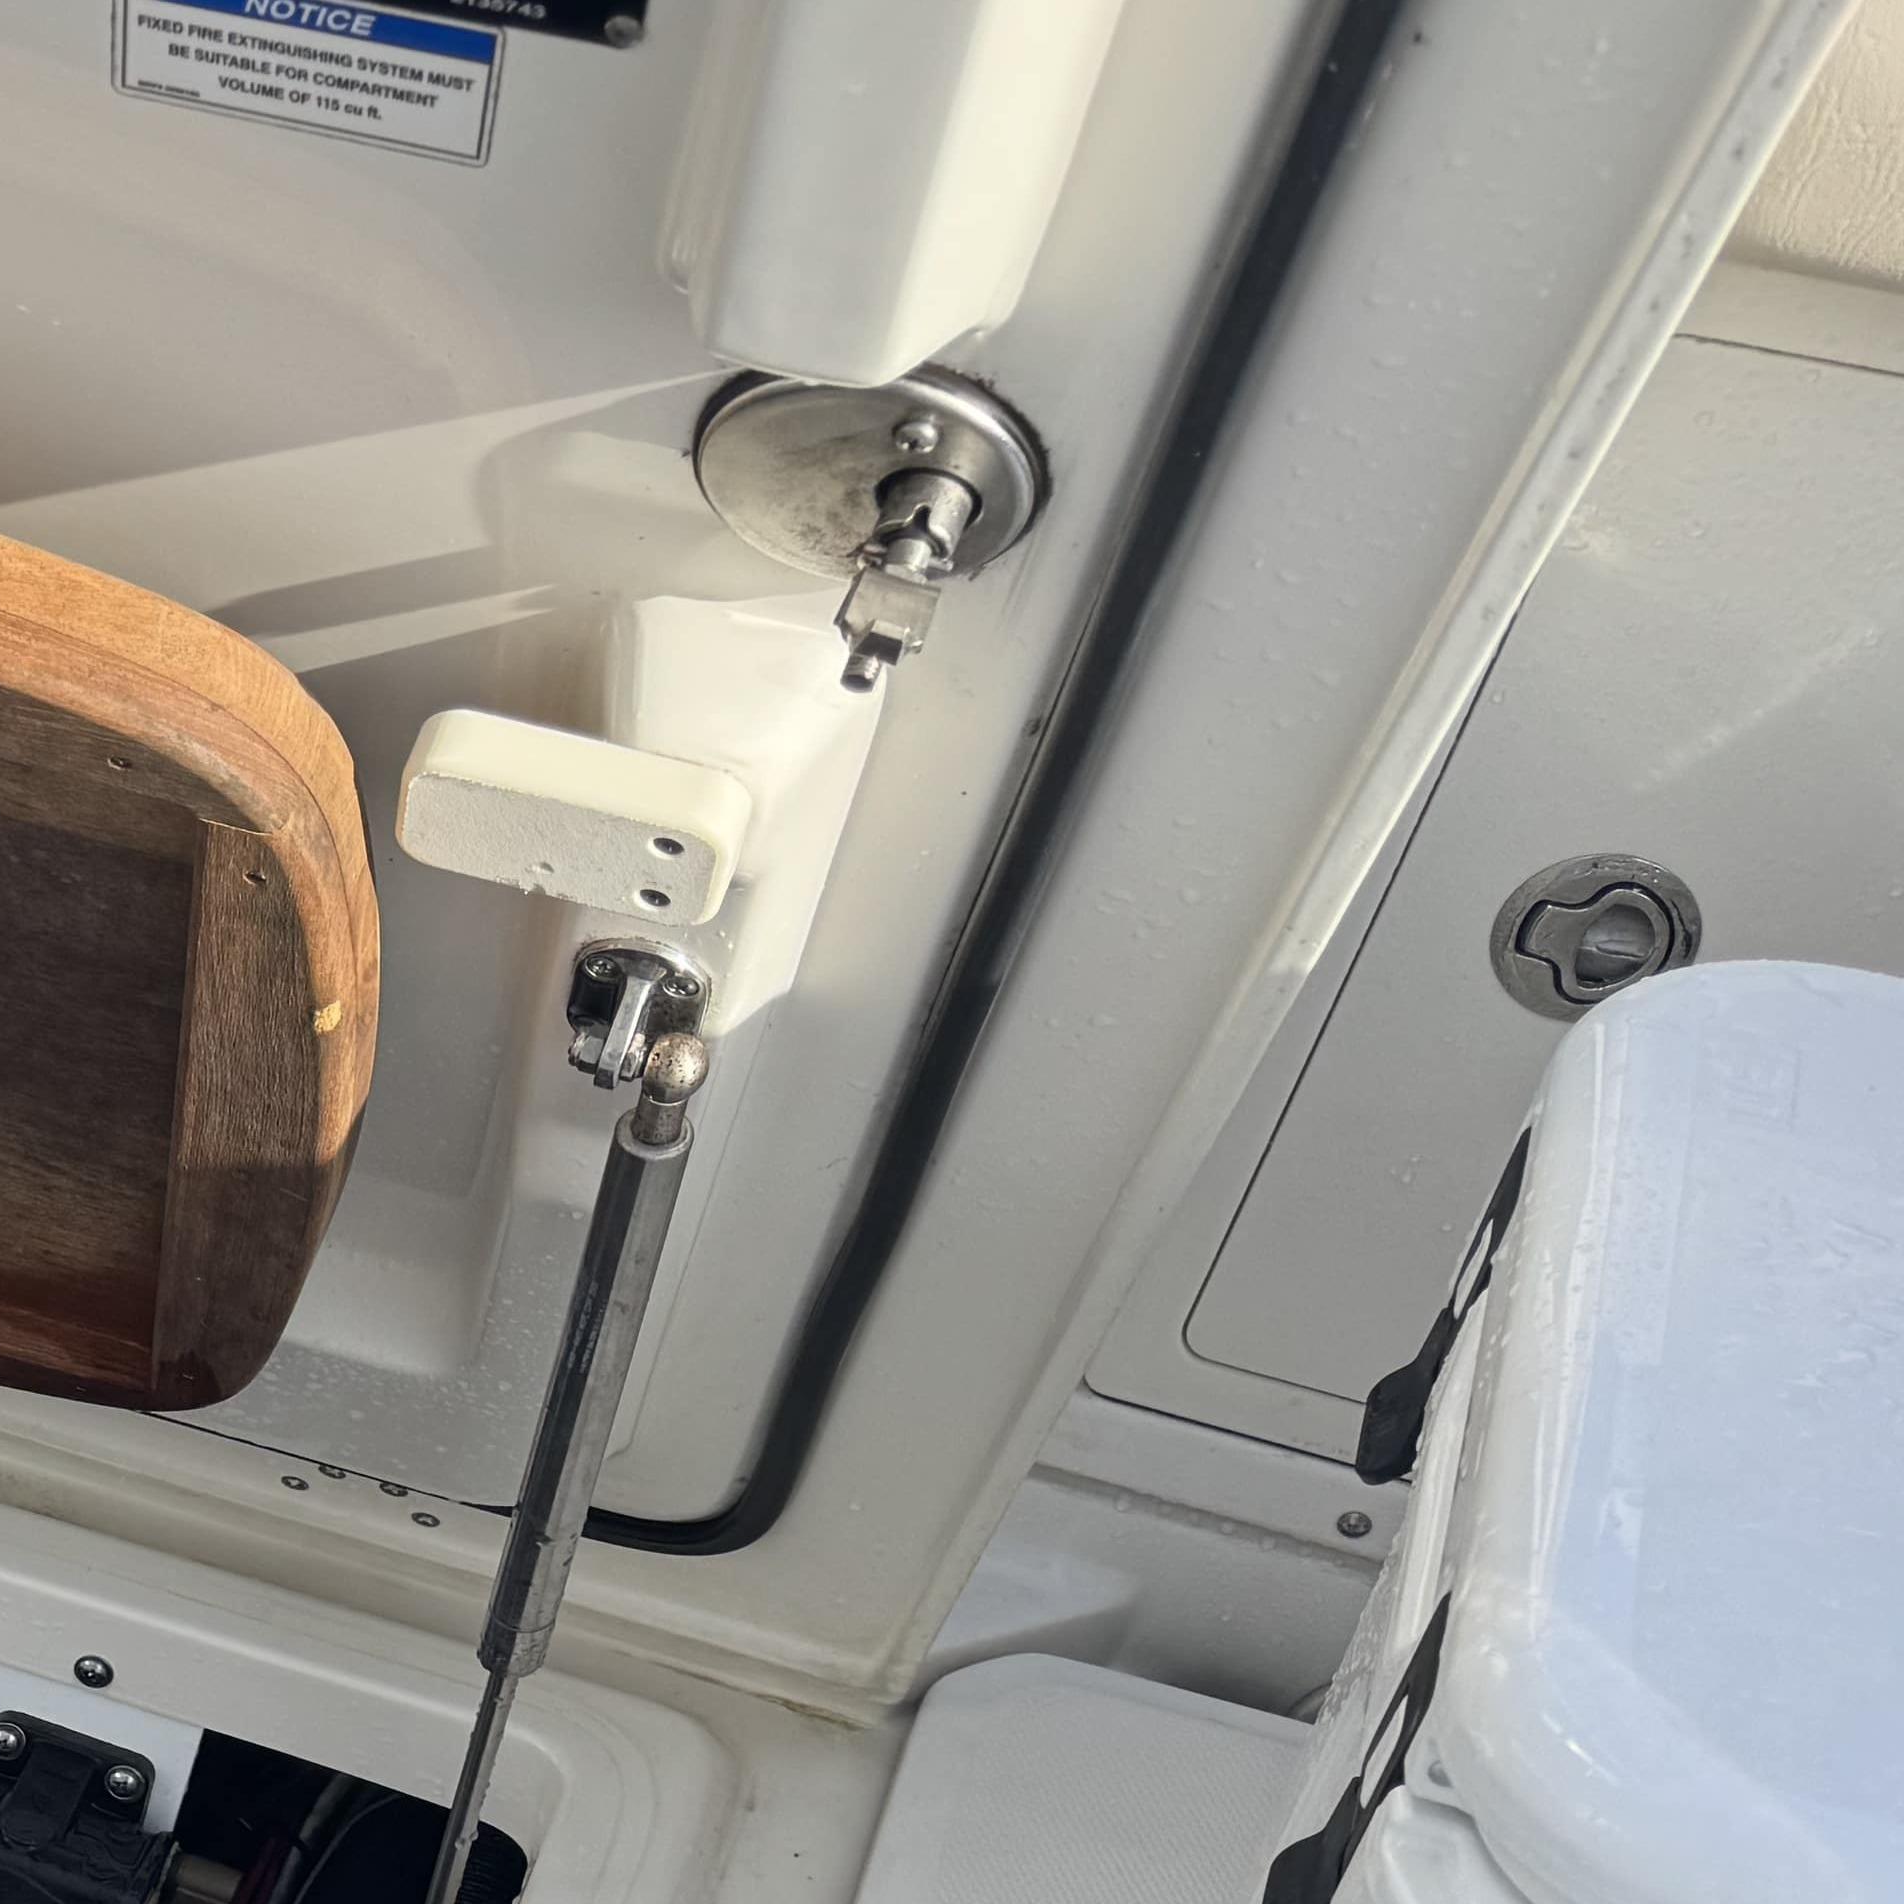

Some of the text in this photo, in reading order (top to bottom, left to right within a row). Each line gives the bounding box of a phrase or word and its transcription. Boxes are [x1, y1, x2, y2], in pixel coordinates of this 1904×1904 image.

[243, 0, 376, 37] NOTICE
[138, 14, 475, 92] FIXED FIRE EXTINGUISHING SYSTEM MUST
[168, 43, 438, 109] BE SUITABLE FOR COMPARTMENT
[218, 75, 284, 100] VOLUME
[289, 90, 311, 106] OF
[317, 96, 340, 112] 115
[344, 104, 364, 117] cu
[366, 105, 383, 121] ft.
